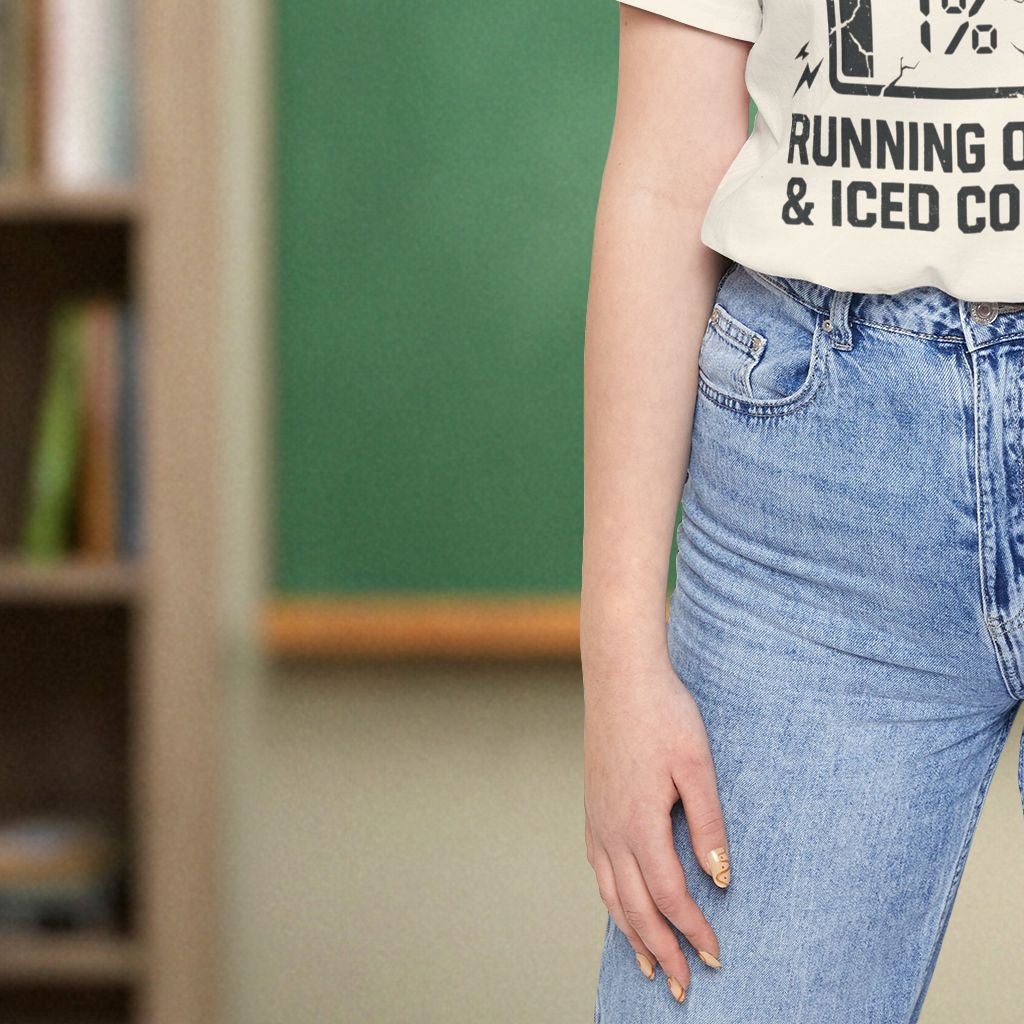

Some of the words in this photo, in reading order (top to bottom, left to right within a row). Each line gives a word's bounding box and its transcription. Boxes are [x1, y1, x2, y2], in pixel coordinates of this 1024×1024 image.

[787, 112, 986, 174] RUNNING
[781, 176, 815, 226] &
[831, 179, 940, 233] ICED
